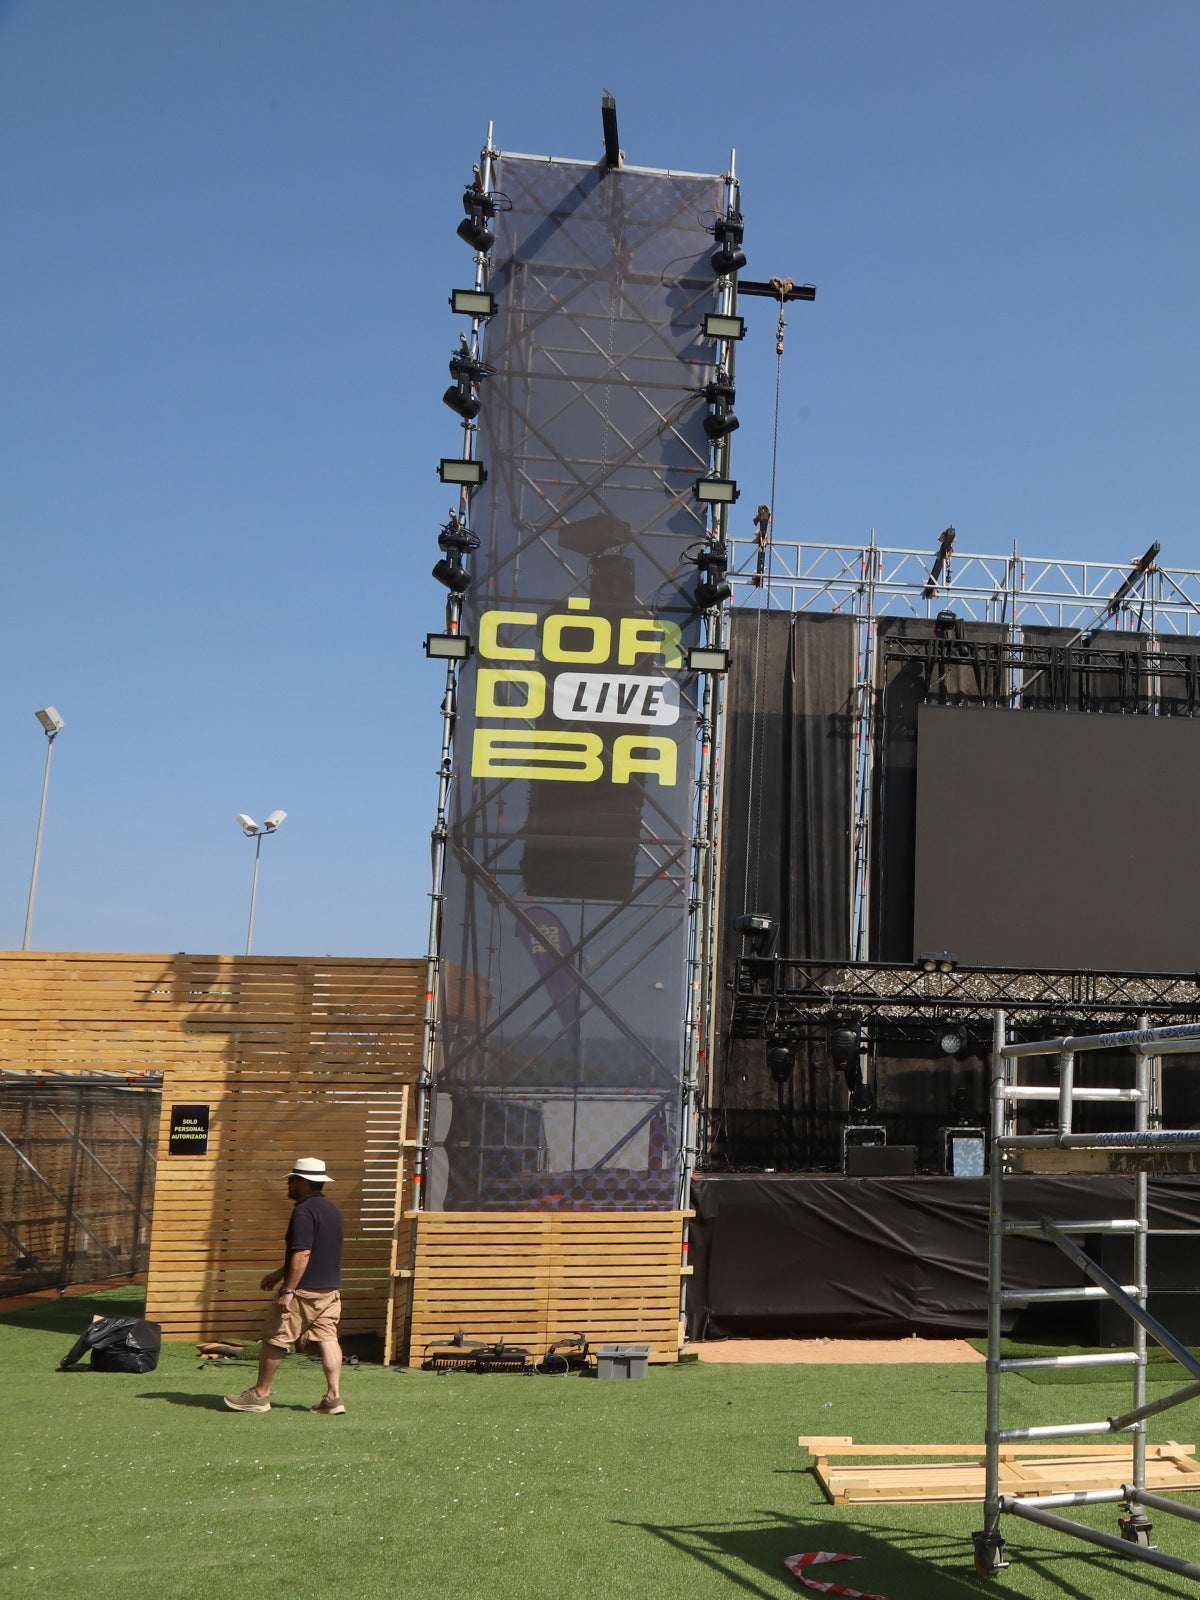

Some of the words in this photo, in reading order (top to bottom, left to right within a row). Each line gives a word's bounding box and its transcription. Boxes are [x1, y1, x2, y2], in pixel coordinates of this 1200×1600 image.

[475, 668, 546, 719] D
[572, 681, 664, 716] LIVE
[471, 728, 678, 786] BA
